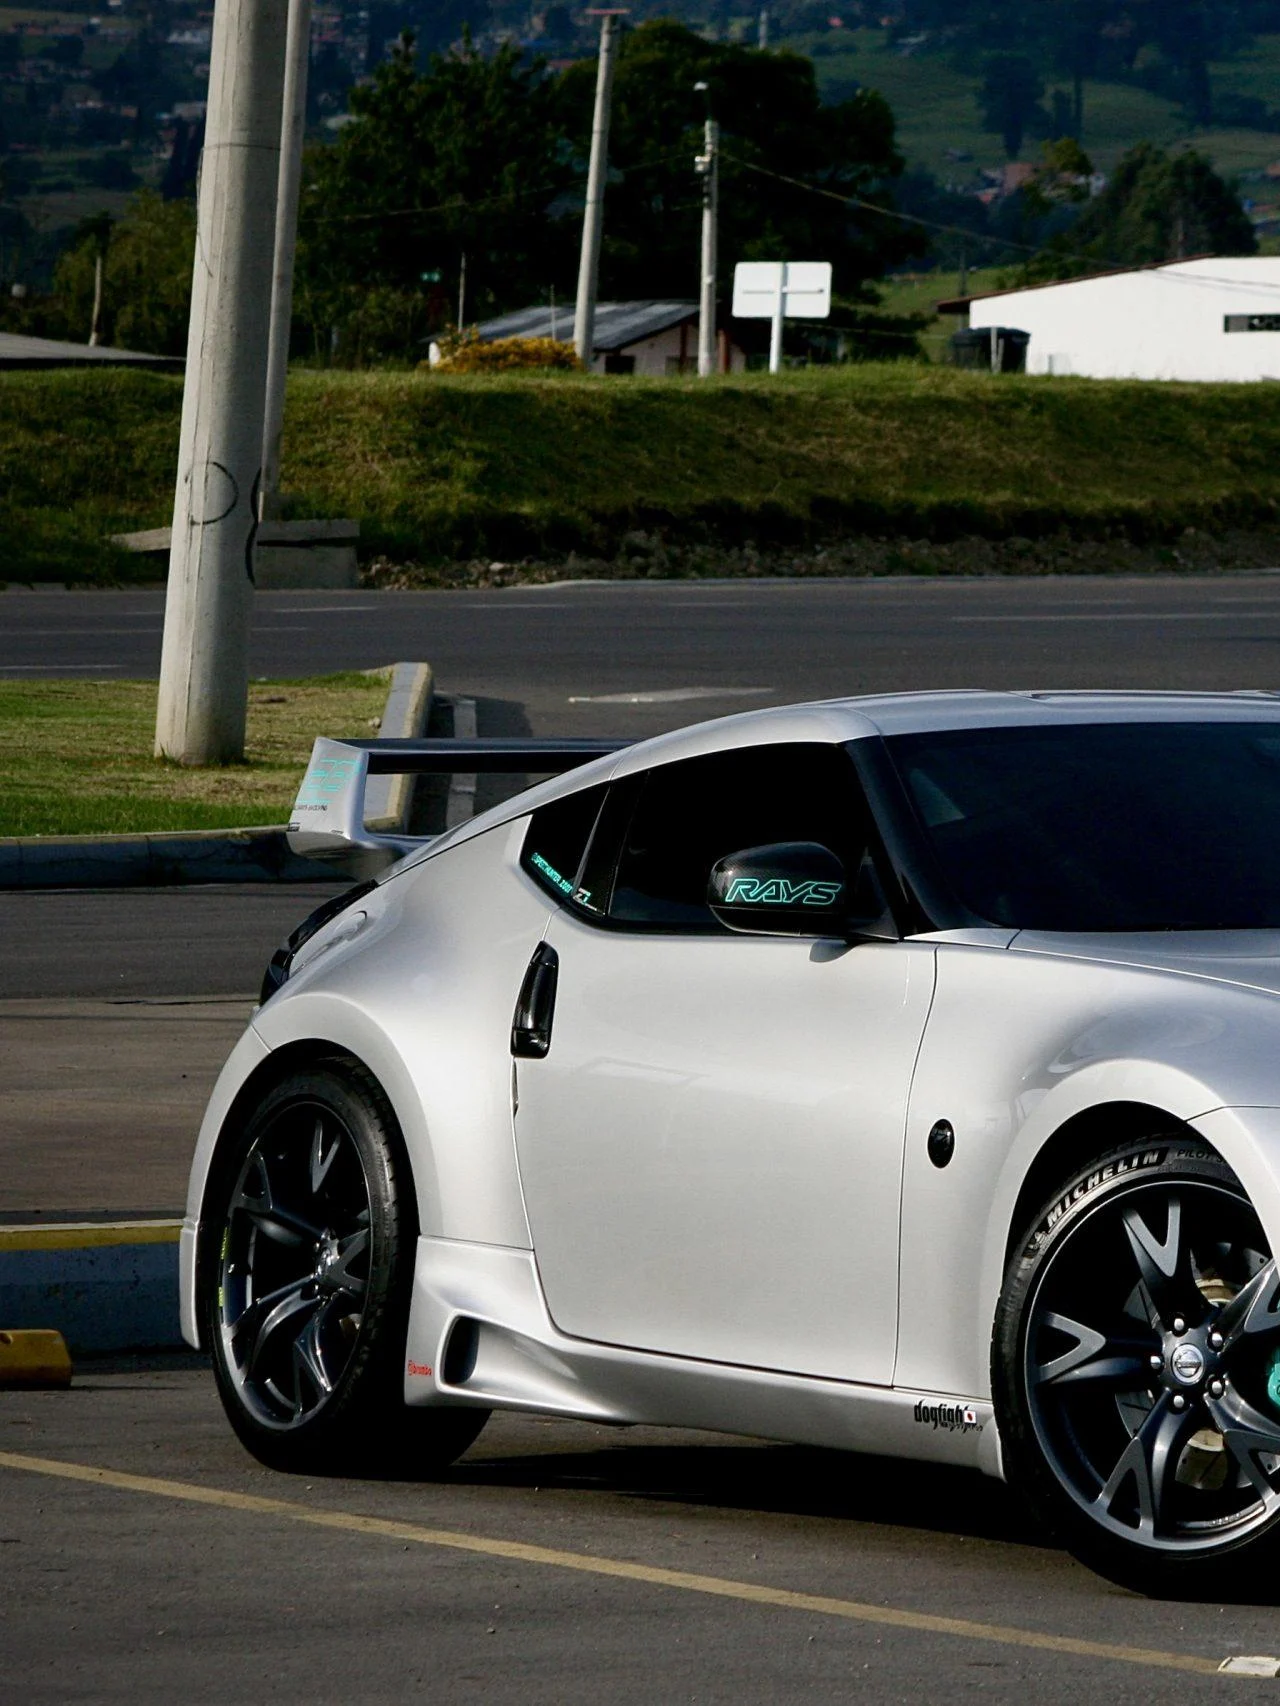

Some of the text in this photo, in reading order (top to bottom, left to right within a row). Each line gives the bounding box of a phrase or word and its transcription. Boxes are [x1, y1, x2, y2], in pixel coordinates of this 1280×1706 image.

[725, 878, 842, 905] RAYS
[1047, 1150, 1159, 1228] MICHELIN
[914, 1399, 969, 1430] dogfigh
